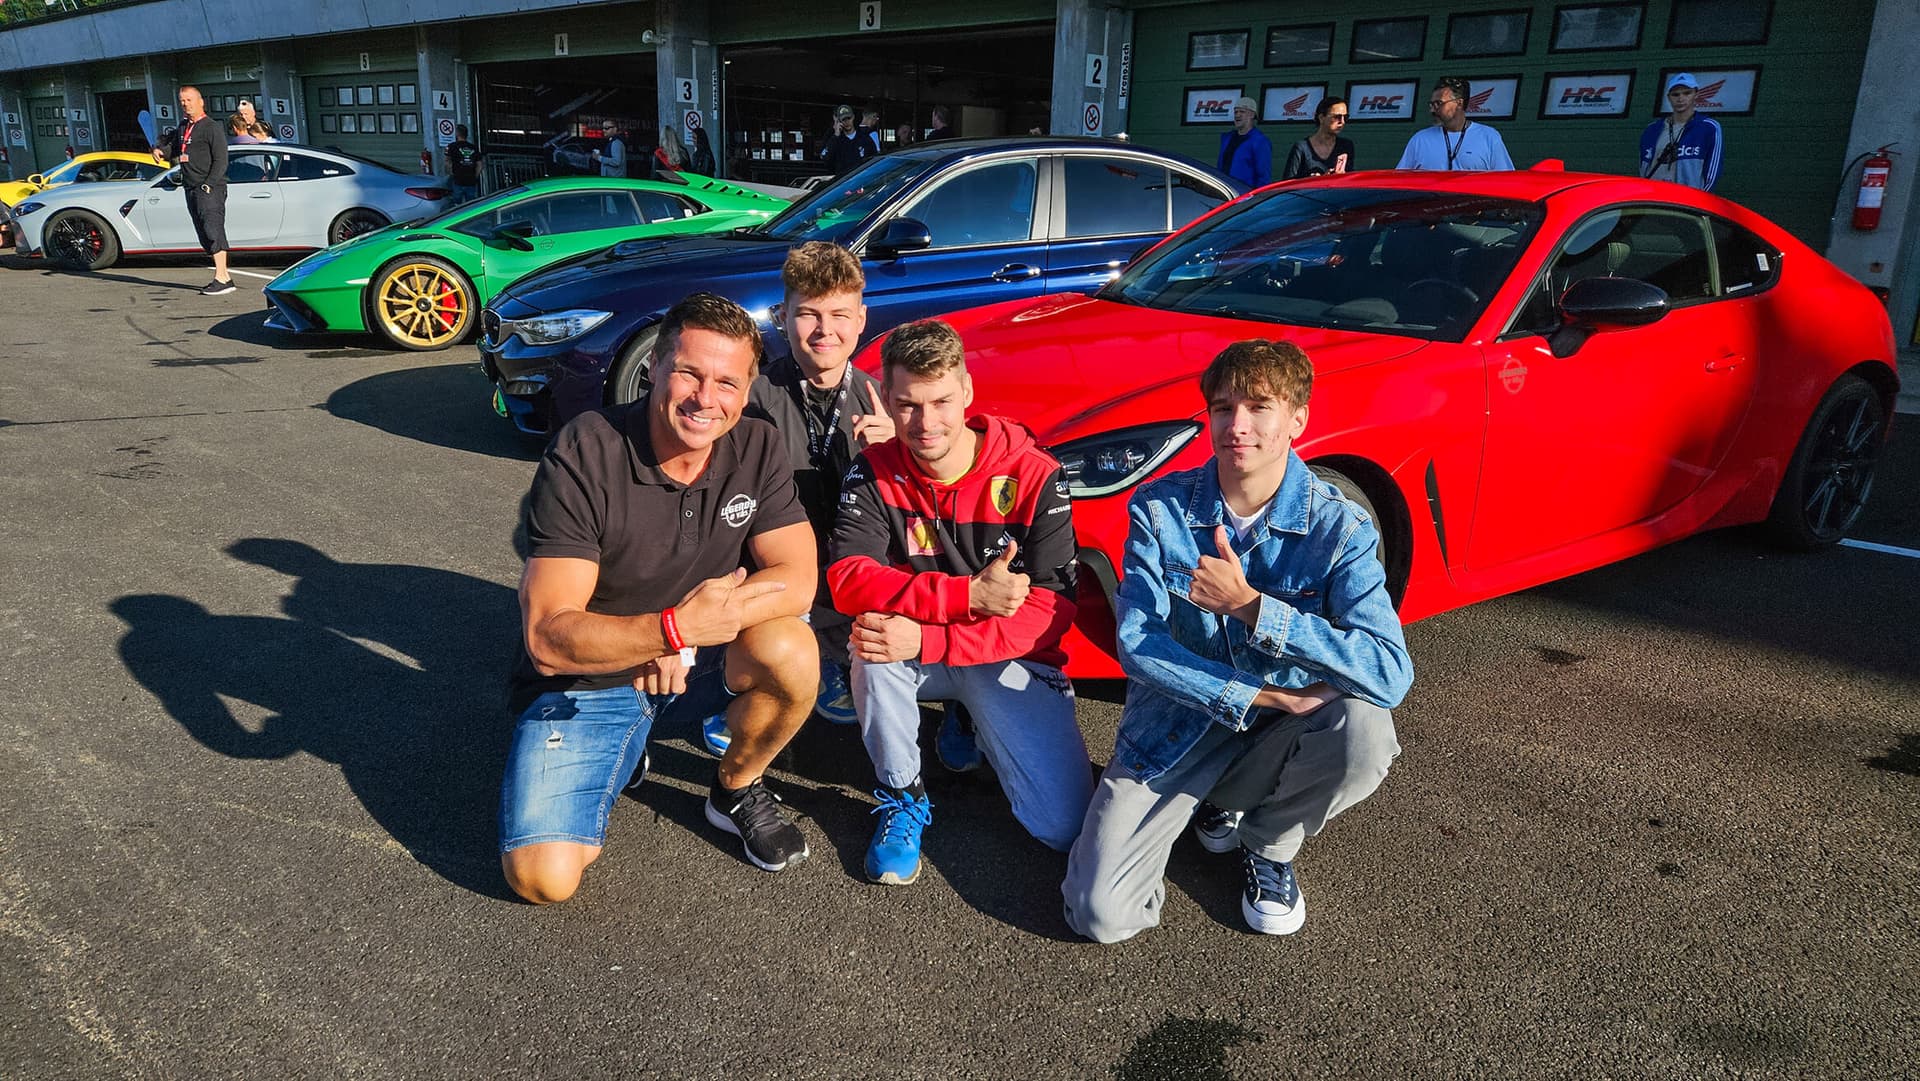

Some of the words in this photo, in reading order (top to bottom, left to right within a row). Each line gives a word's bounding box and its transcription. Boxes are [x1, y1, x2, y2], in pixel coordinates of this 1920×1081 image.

[866, 4, 875, 28] 3
[1092, 58, 1102, 85] 2
[683, 81, 692, 100] 3
[1560, 86, 1616, 103] HRC
[277, 100, 285, 113] 5
[440, 93, 448, 109] 4
[1194, 100, 1232, 113] HRC
[1359, 95, 1404, 110] HRC
[8, 113, 15, 123] 8
[74, 110, 81, 120] 7
[161, 106, 169, 118] 6
[841, 492, 858, 504] HLE
